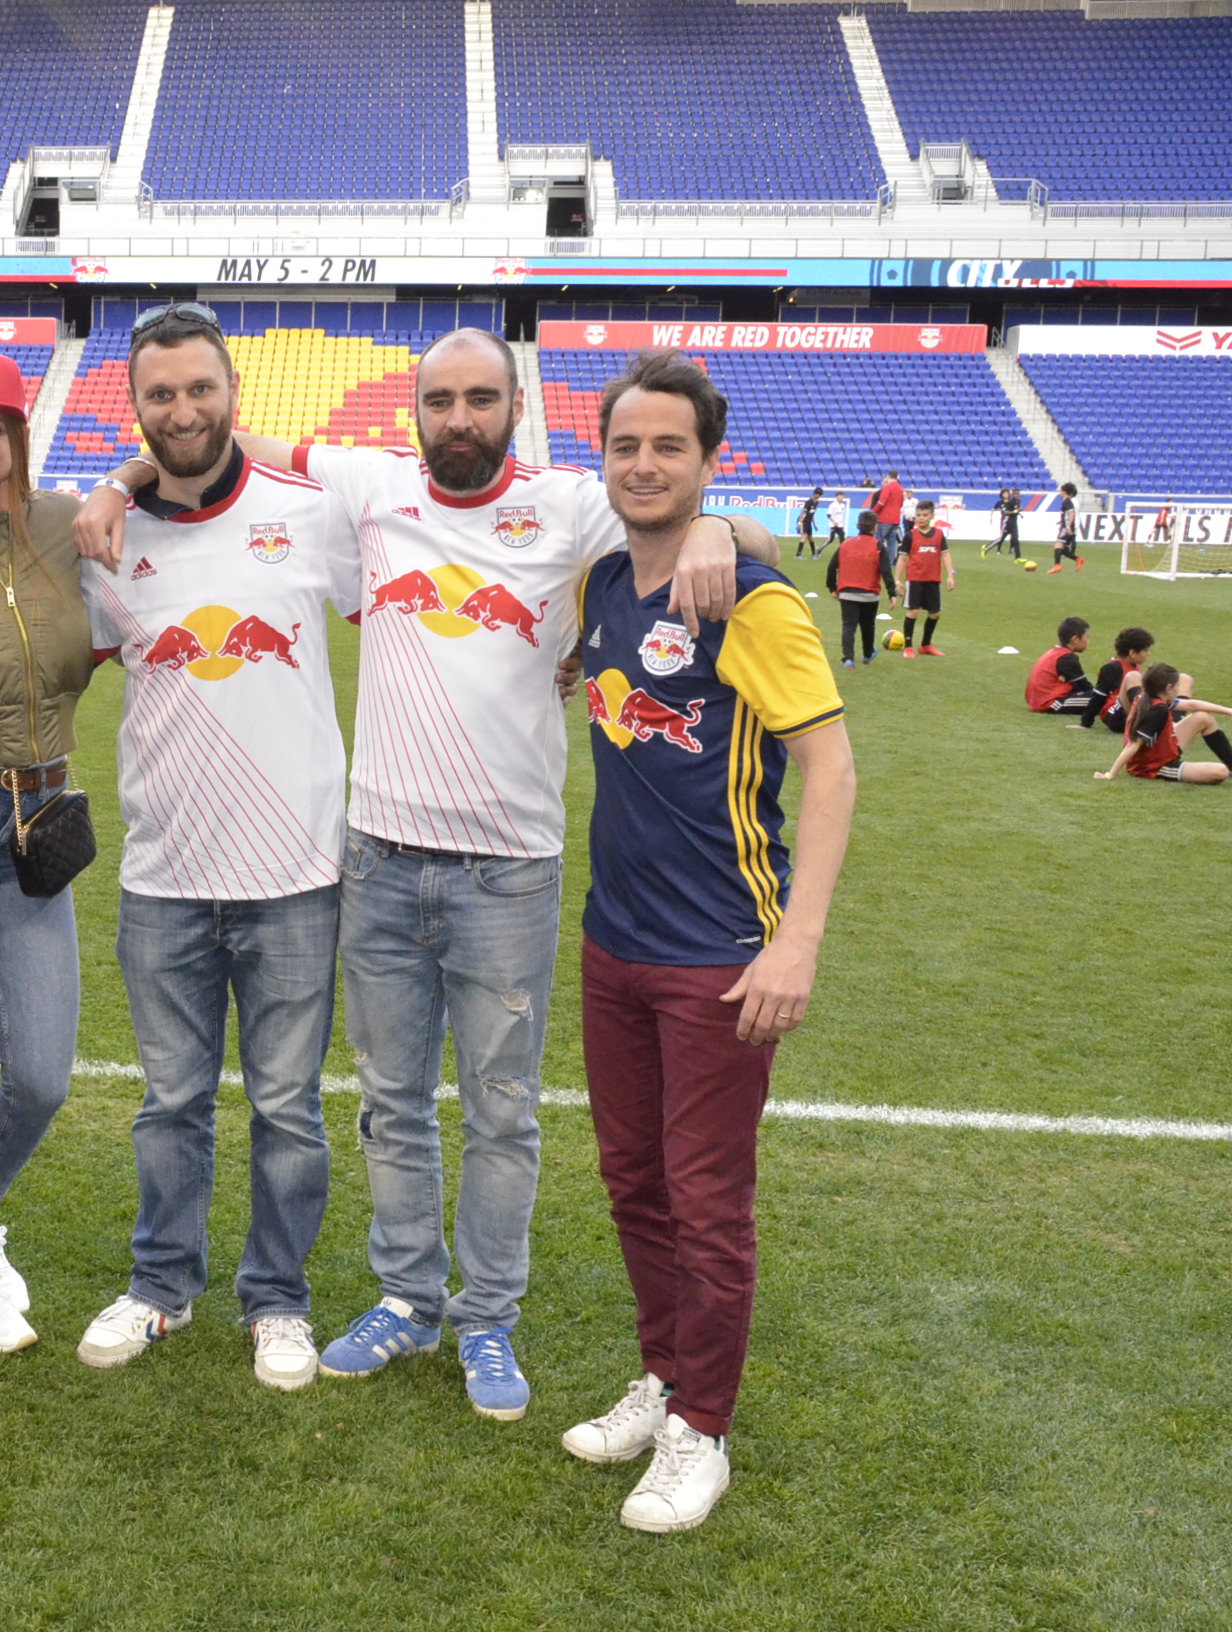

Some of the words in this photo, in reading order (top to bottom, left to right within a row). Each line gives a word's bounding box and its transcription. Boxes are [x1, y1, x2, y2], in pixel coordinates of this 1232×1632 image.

[217, 259, 269, 282] MAY
[277, 259, 292, 282] 5
[318, 259, 334, 282] 2
[341, 259, 377, 282] PM
[652, 325, 683, 346] WE
[687, 326, 727, 347] ARE
[731, 326, 770, 348] RED
[776, 327, 874, 349] TOGETHER
[499, 510, 515, 518] Red
[516, 509, 533, 517] Bull
[252, 526, 268, 535] Red
[269, 526, 285, 534] Bull
[670, 631, 686, 642] Bull
